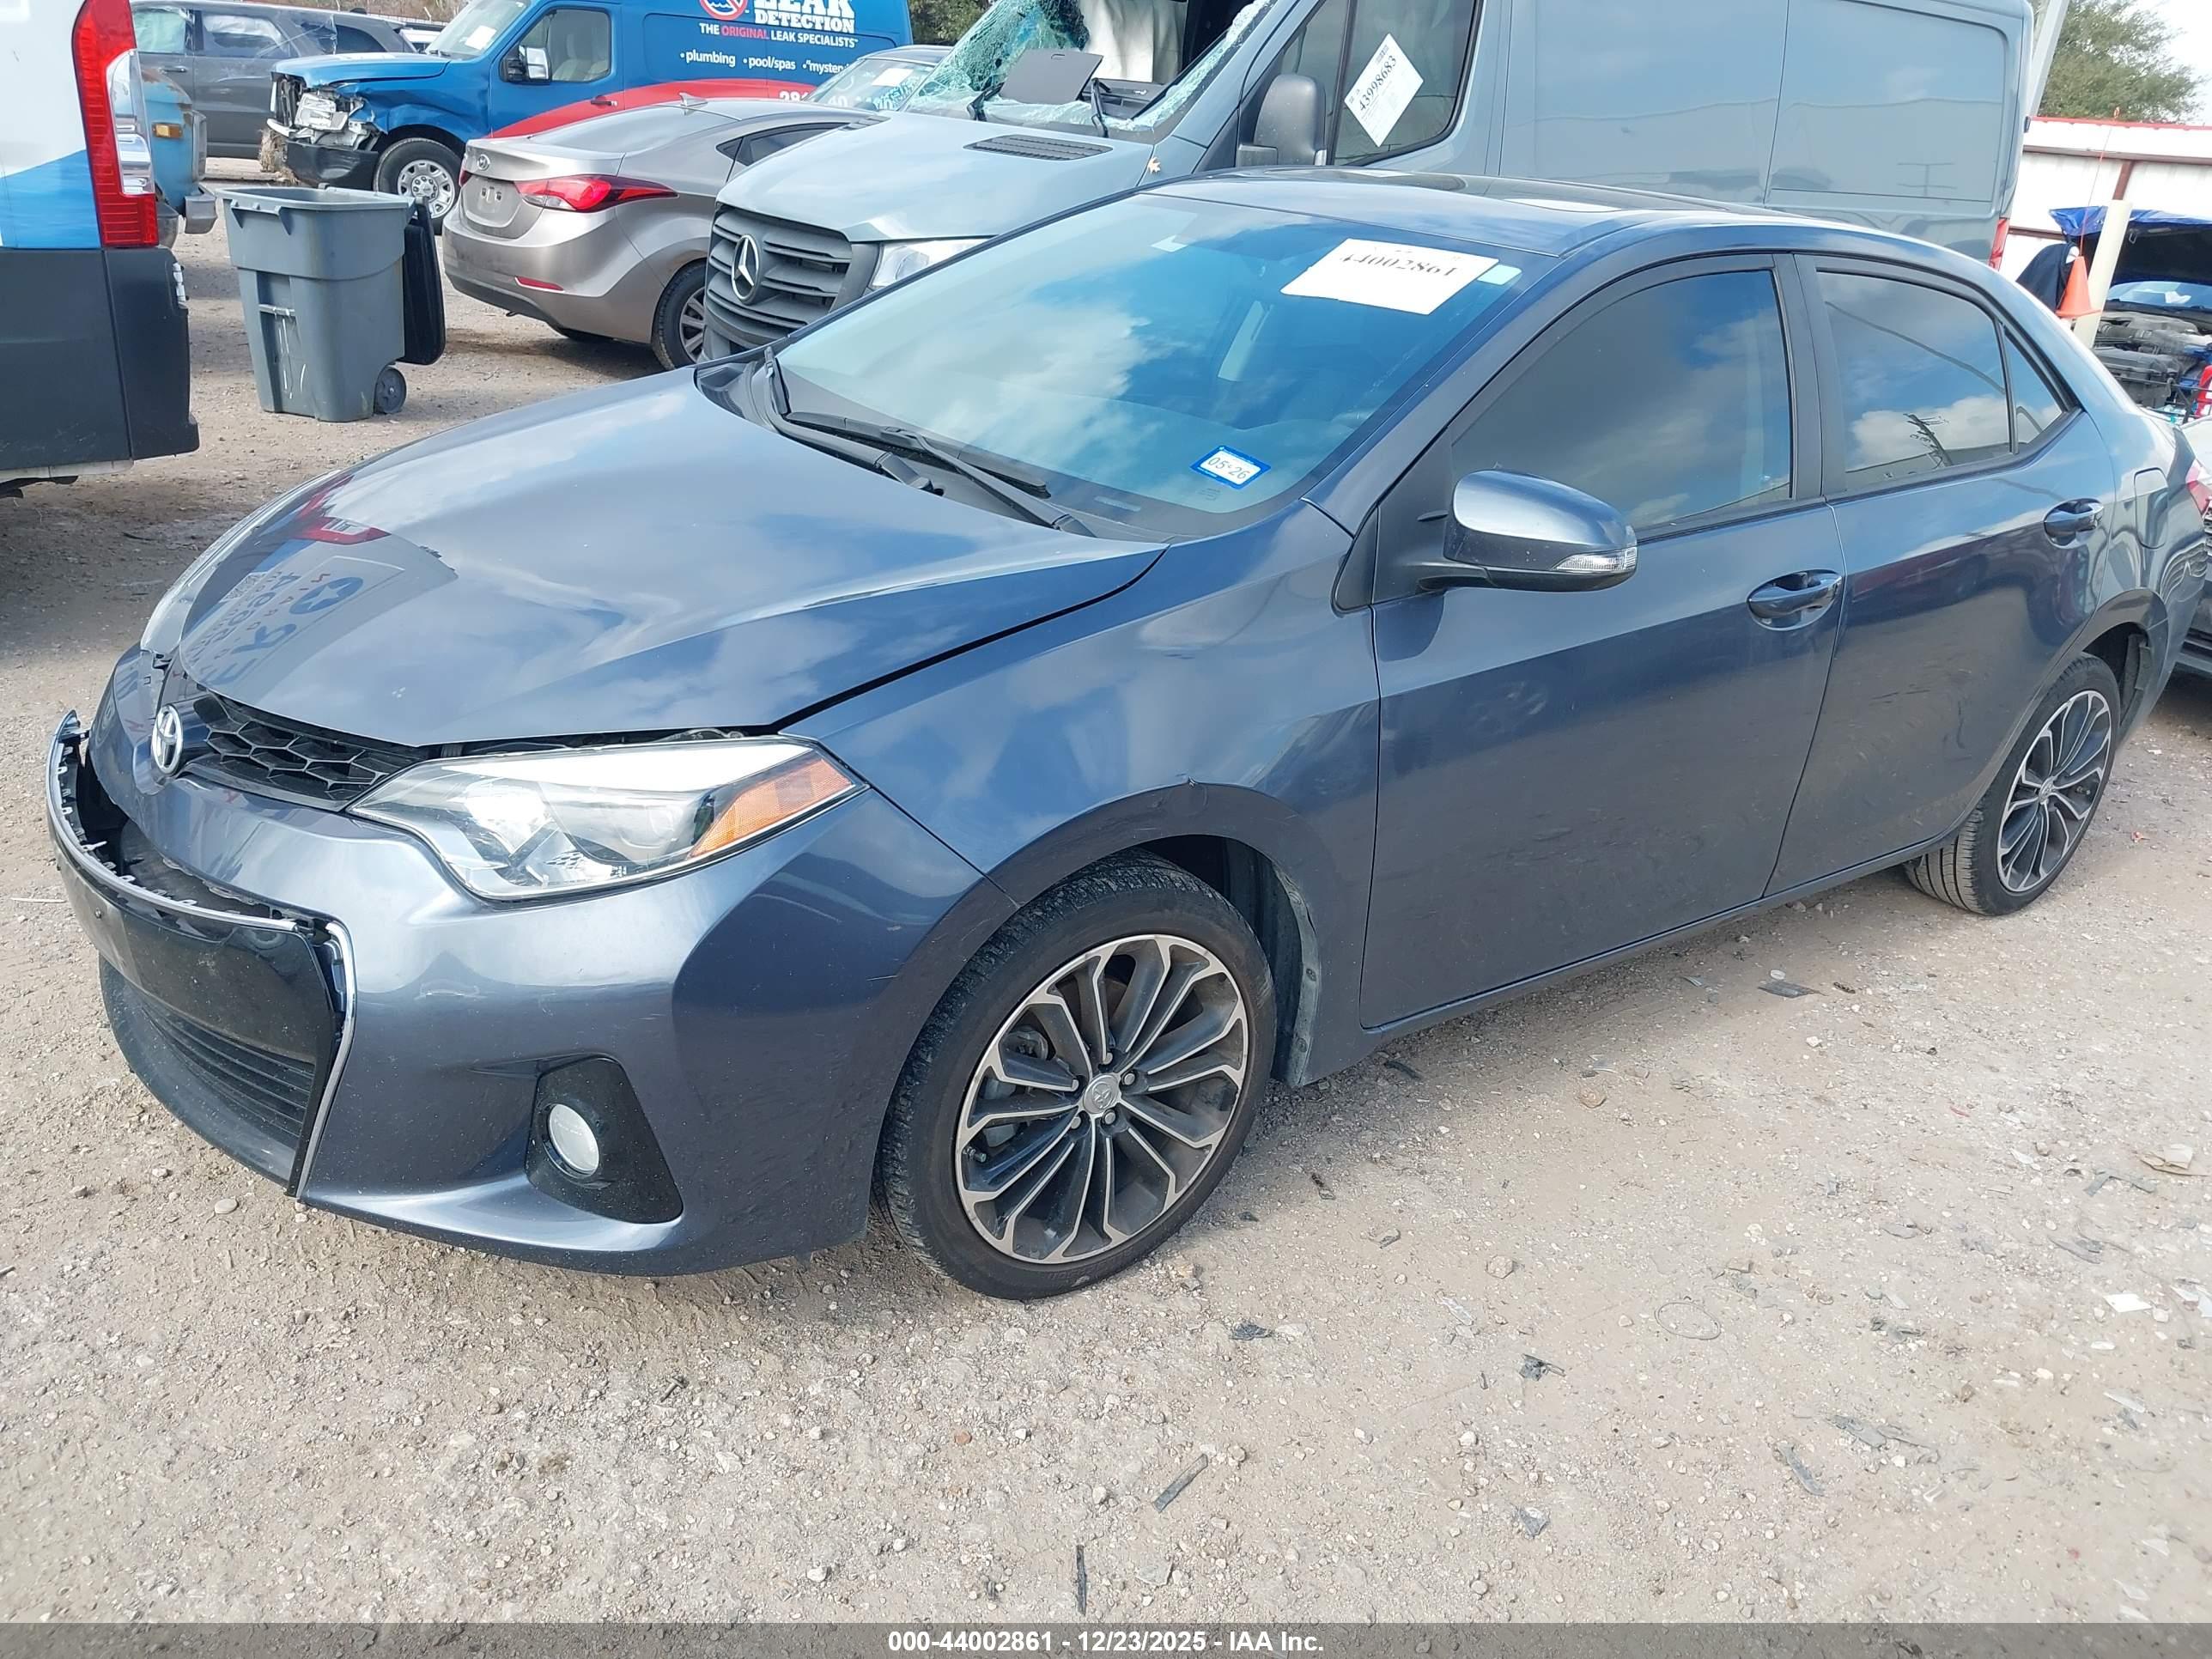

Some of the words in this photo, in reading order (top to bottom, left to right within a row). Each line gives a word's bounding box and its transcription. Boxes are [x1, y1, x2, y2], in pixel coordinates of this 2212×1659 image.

[699, 22, 720, 35] THE
[721, 26, 769, 40] ORIGINAL
[770, 30, 797, 42] LEAK
[755, 9, 854, 33] DETECTION
[1359, 55, 1396, 111] 43998683
